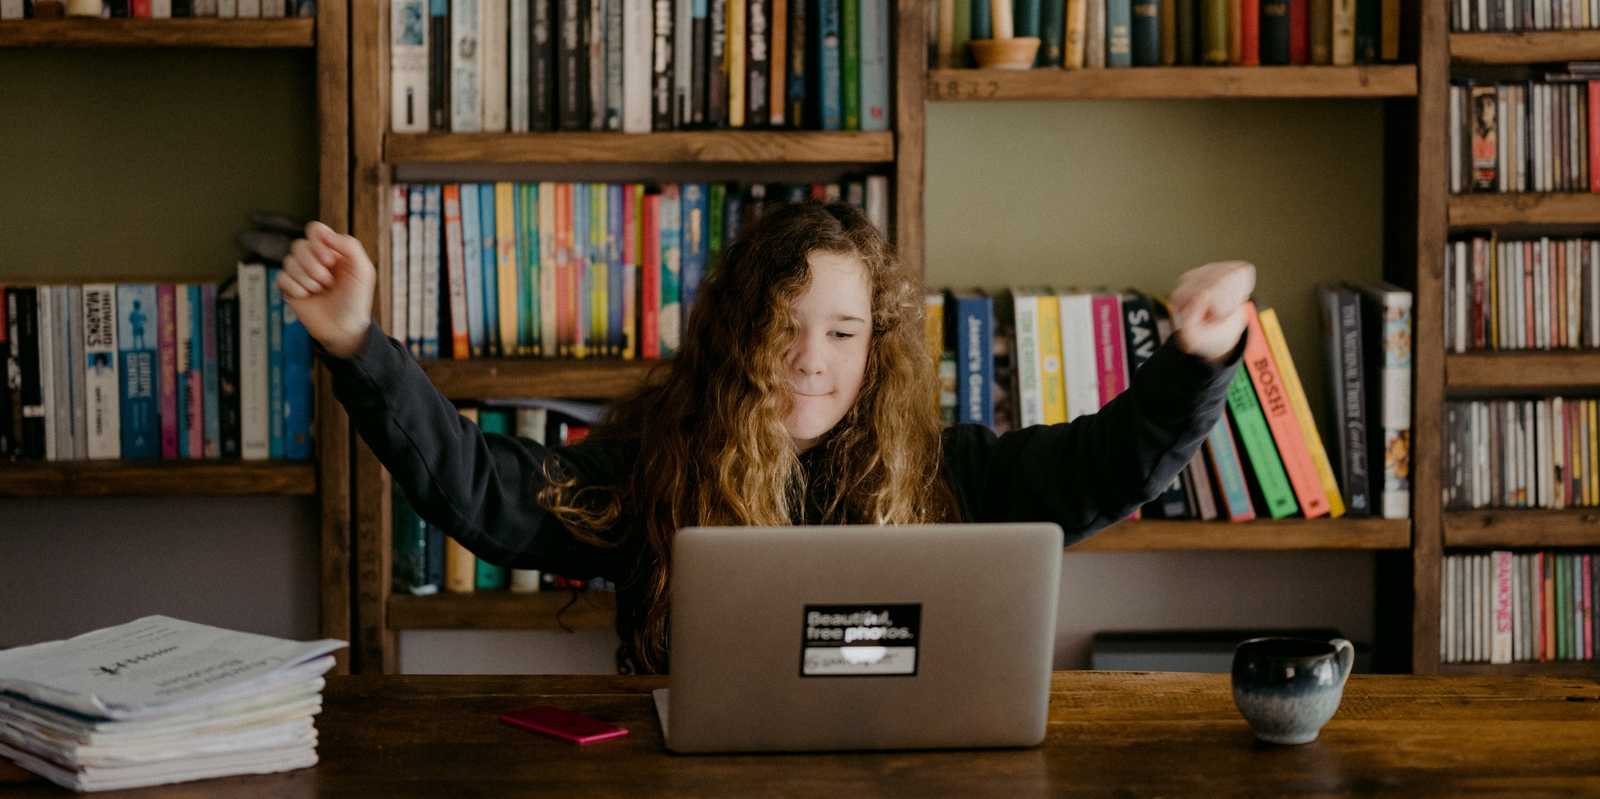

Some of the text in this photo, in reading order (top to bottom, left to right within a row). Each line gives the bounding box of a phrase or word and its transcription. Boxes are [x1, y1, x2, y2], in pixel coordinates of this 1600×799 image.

[1128, 308, 1155, 368] SAV
[968, 373, 983, 421] GREAT
[1254, 357, 1287, 416] BOSH!
[807, 627, 913, 642] free photos.
